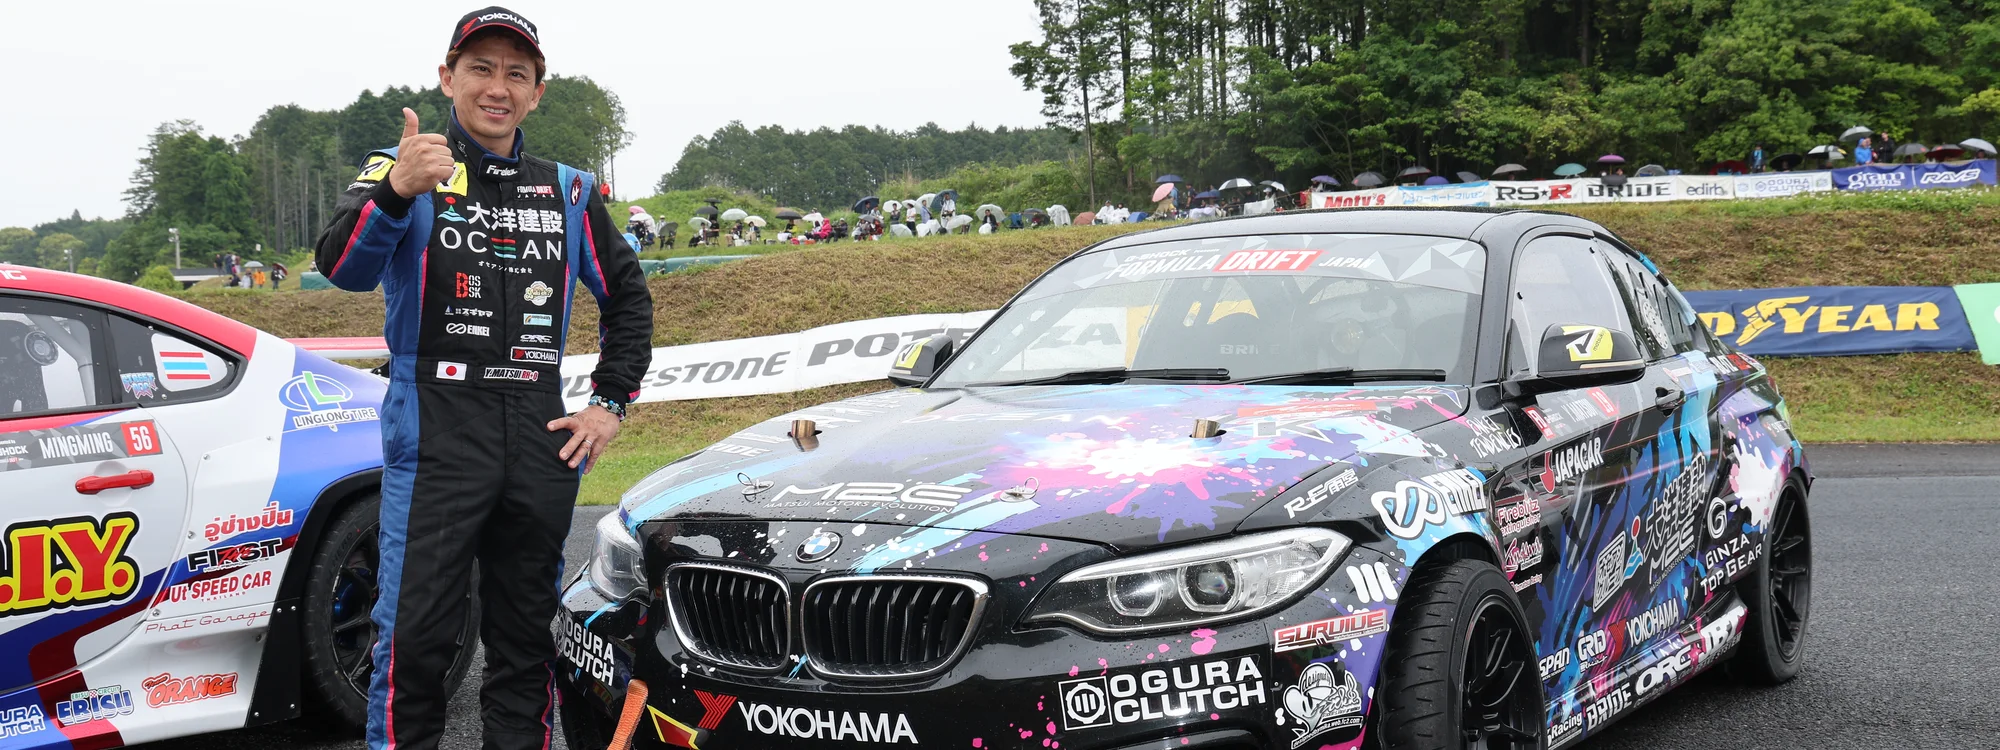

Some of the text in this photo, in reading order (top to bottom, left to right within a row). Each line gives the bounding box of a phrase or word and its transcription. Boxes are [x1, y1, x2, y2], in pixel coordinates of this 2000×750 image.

[478, 13, 537, 40] YOKOHAMA
[1587, 182, 1672, 197] BRIDE
[1767, 178, 1810, 186] OGURA
[1848, 171, 1906, 189] gram
[1920, 168, 1981, 184] RAYS
[466, 202, 564, 235] 大洋建設
[440, 226, 562, 260] OCEAN
[1105, 250, 1376, 280] FORMULA DRIFT JAPAN
[467, 324, 490, 336] ENKEI
[524, 351, 555, 361] YOKOHAMA
[294, 408, 376, 427] LINGLONG TIRE
[38, 425, 153, 460] MINGMING 56
[1555, 437, 1604, 483] JAPACAR
[763, 500, 954, 513] MATSUI MOTORS EVOLUTION
[1497, 498, 1541, 525] Fireblitz
[1500, 512, 1541, 537] extinguisher
[1705, 533, 1750, 570] GINZA
[1700, 543, 1762, 595] TOP GEAR
[171, 570, 272, 602] Ut SPEED CAR
[201, 591, 246, 602] THAILAND
[145, 610, 272, 634] Phat Garage
[1626, 598, 1679, 647] YOKOHAMA
[565, 616, 614, 665] OGURA
[1577, 629, 1607, 661] GRID
[563, 637, 614, 686] CLUTCH
[1539, 648, 1570, 677] SPAN
[1636, 644, 1692, 695] ORC
[71, 686, 120, 699] EBISU CIRCUIT
[150, 676, 236, 705] ORANGE
[1110, 657, 1262, 698] OGURA
[56, 691, 134, 726] EBISU
[1113, 680, 1266, 723] CLUTCH
[1586, 682, 1632, 731] BRIDE
[738, 701, 918, 744] YOKOHAMA
